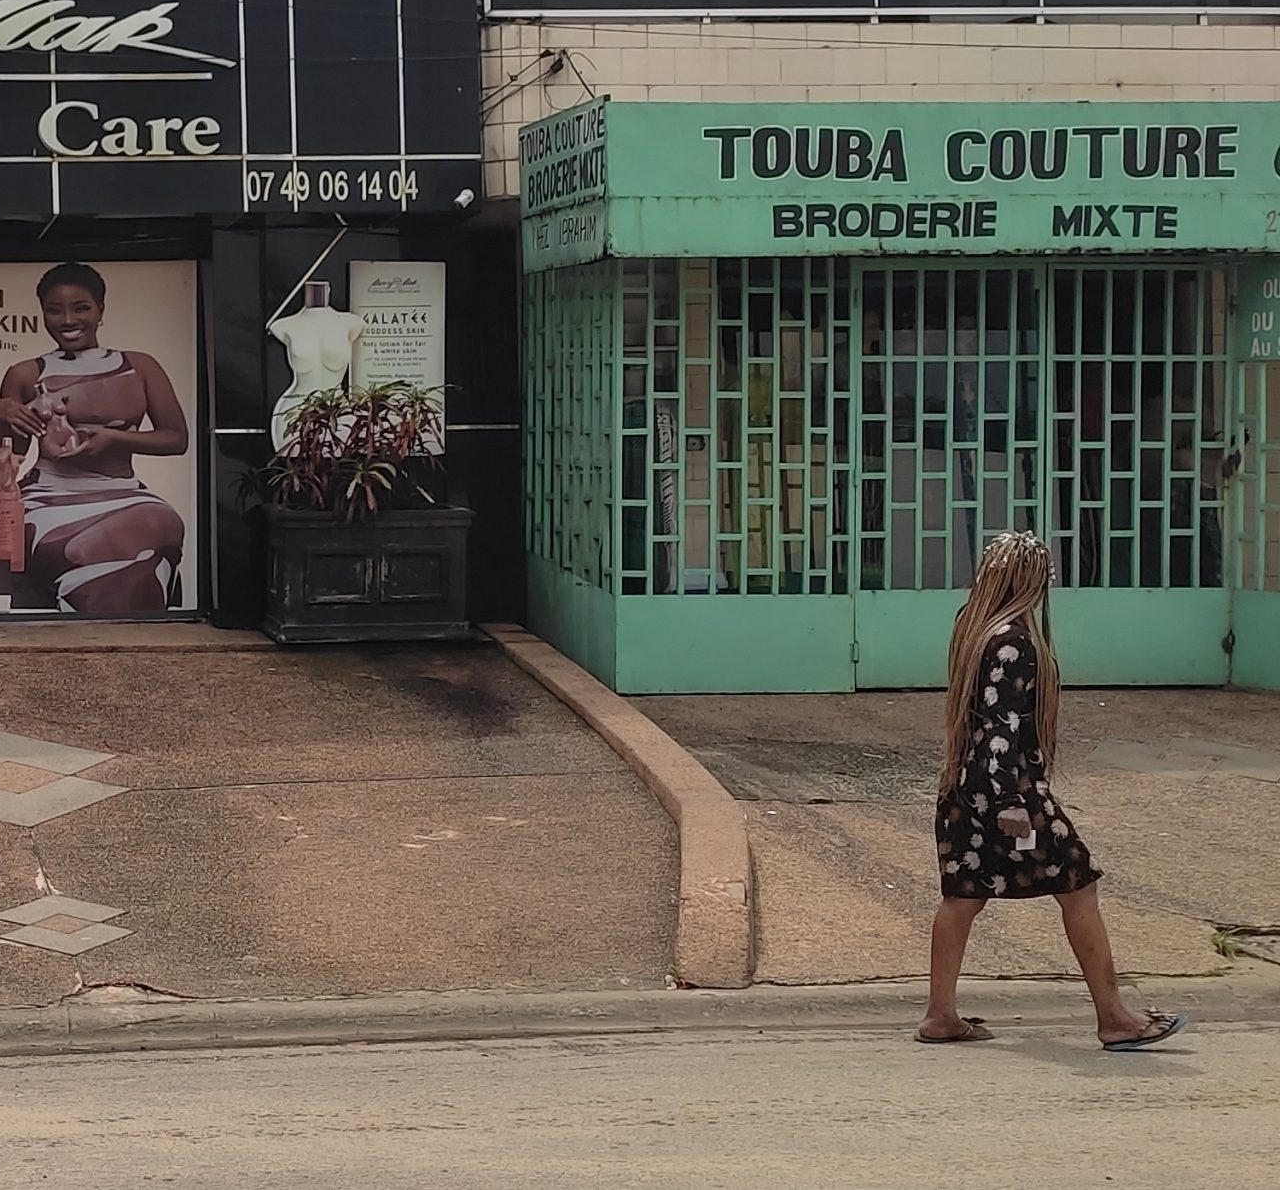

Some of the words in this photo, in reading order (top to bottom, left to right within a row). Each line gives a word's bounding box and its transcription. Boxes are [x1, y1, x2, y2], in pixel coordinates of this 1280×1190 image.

[37, 99, 222, 158] Care
[518, 124, 553, 167] TOUBA
[554, 105, 605, 154] COUTURE
[701, 125, 909, 182] TOUBA
[945, 124, 1240, 183] COUTURE
[246, 170, 275, 202] 07
[279, 170, 310, 202] 49
[318, 170, 350, 202] 06
[356, 170, 384, 202] 14
[388, 170, 419, 201] 04
[528, 154, 578, 209] BRODERIE
[579, 144, 606, 192] MIXTE
[558, 214, 597, 246] IBRAHIM
[771, 201, 999, 239] BRODERIE
[1051, 204, 1179, 240] MIXTE
[362, 310, 428, 325] GALATÉE
[365, 327, 404, 335] GODDESS
[406, 327, 426, 335] SKIN
[1252, 311, 1274, 332] DU
[1250, 337, 1271, 358] Au
